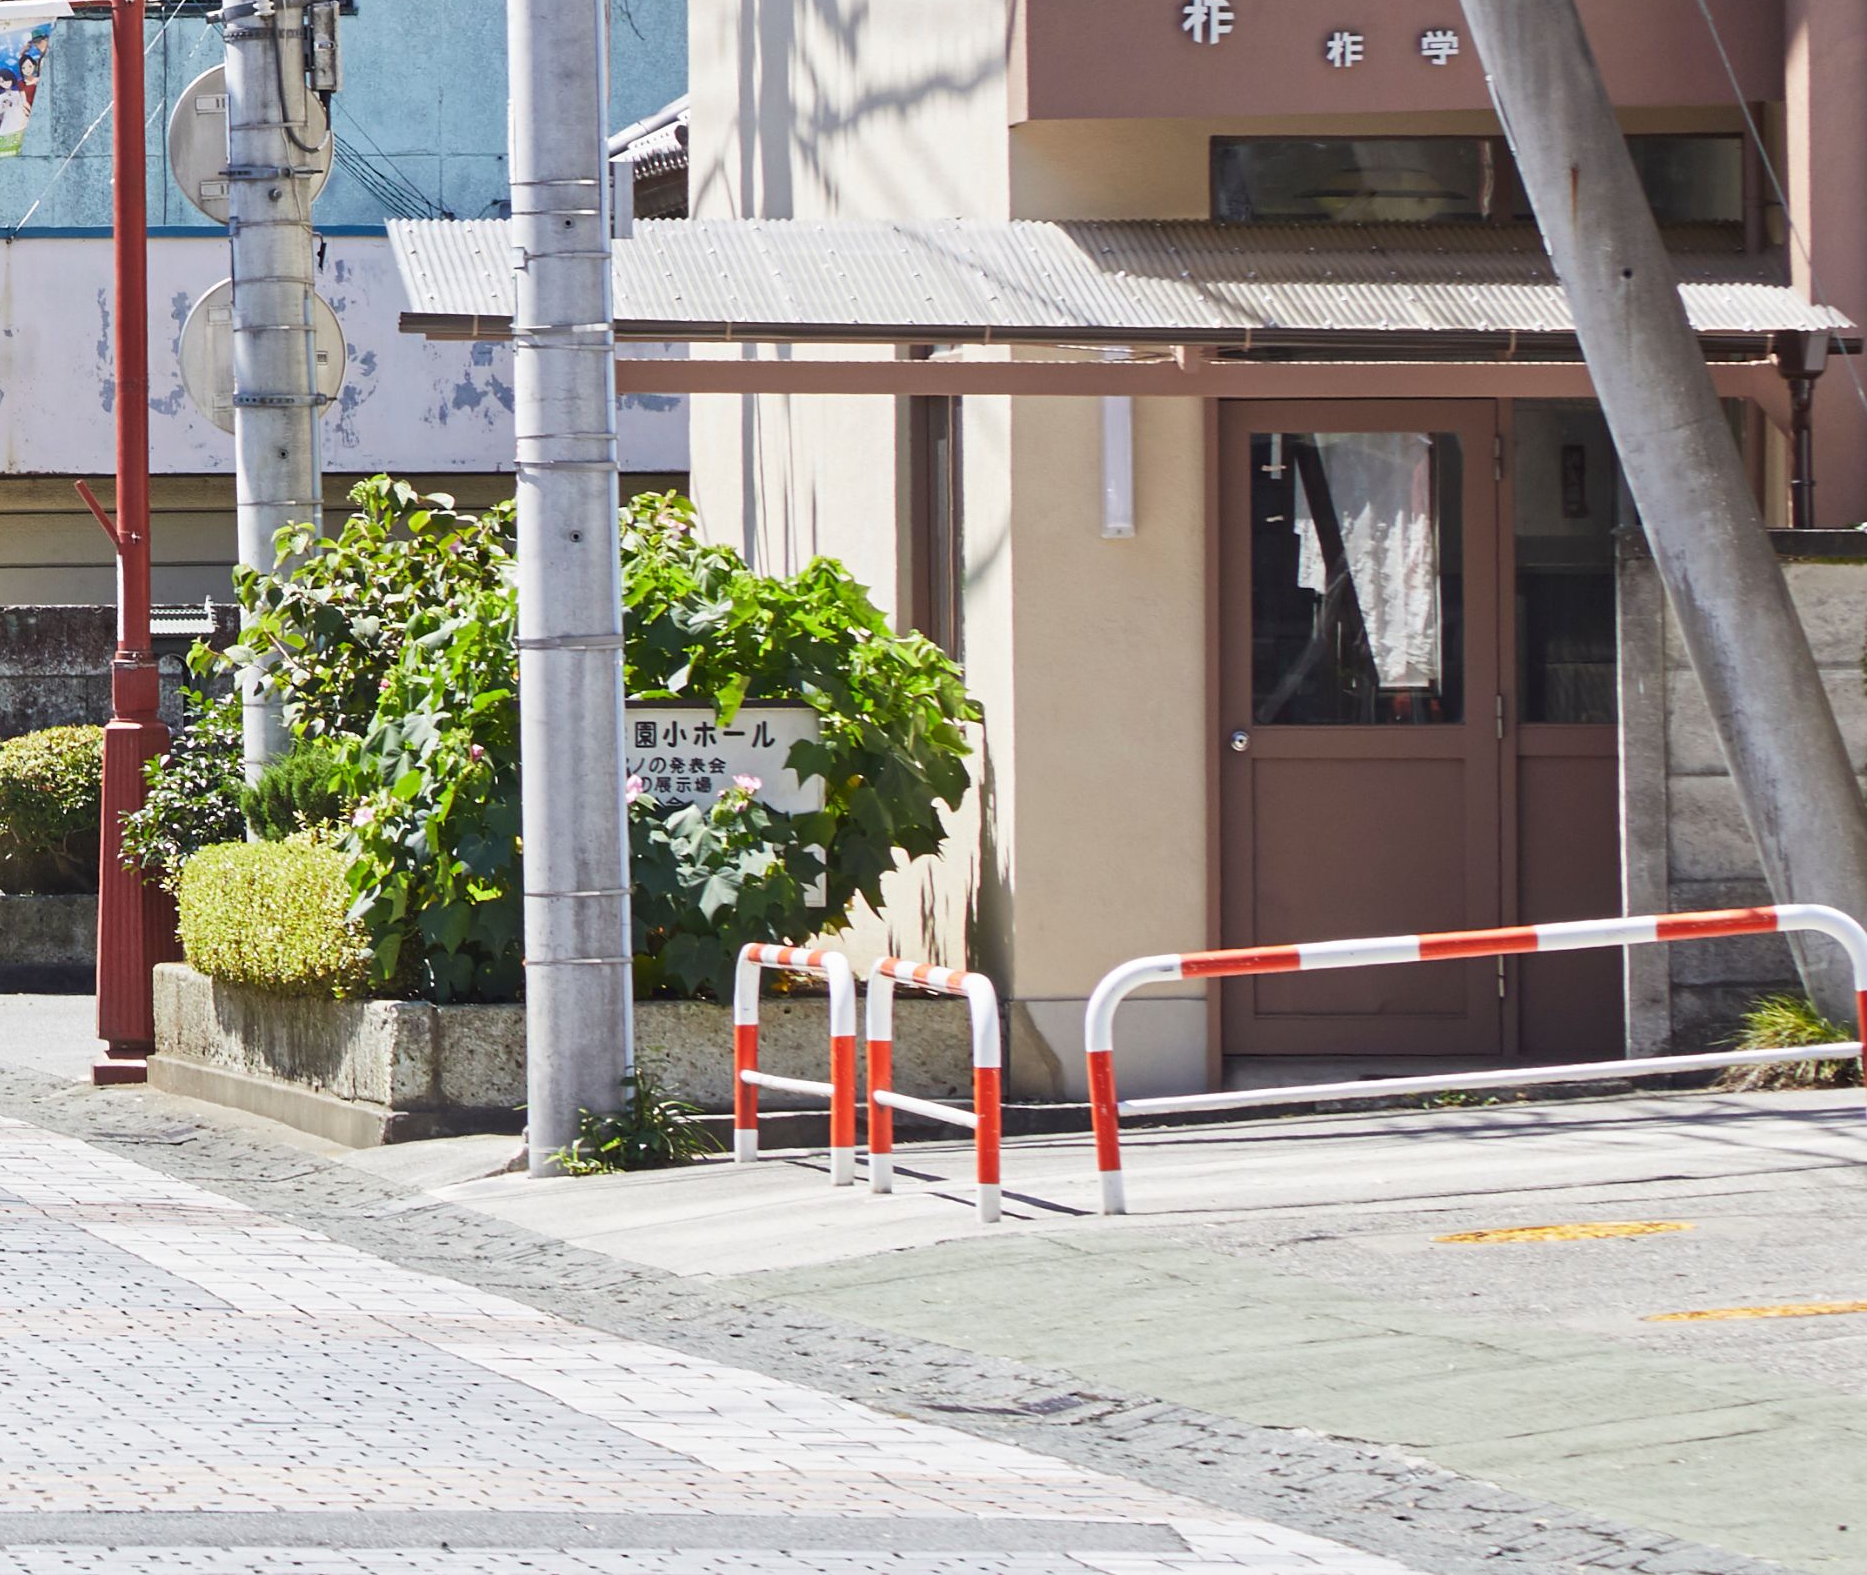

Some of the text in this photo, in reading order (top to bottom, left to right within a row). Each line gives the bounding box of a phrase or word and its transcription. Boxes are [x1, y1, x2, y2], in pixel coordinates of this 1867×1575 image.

[634, 721, 775, 748] 園小ホール
